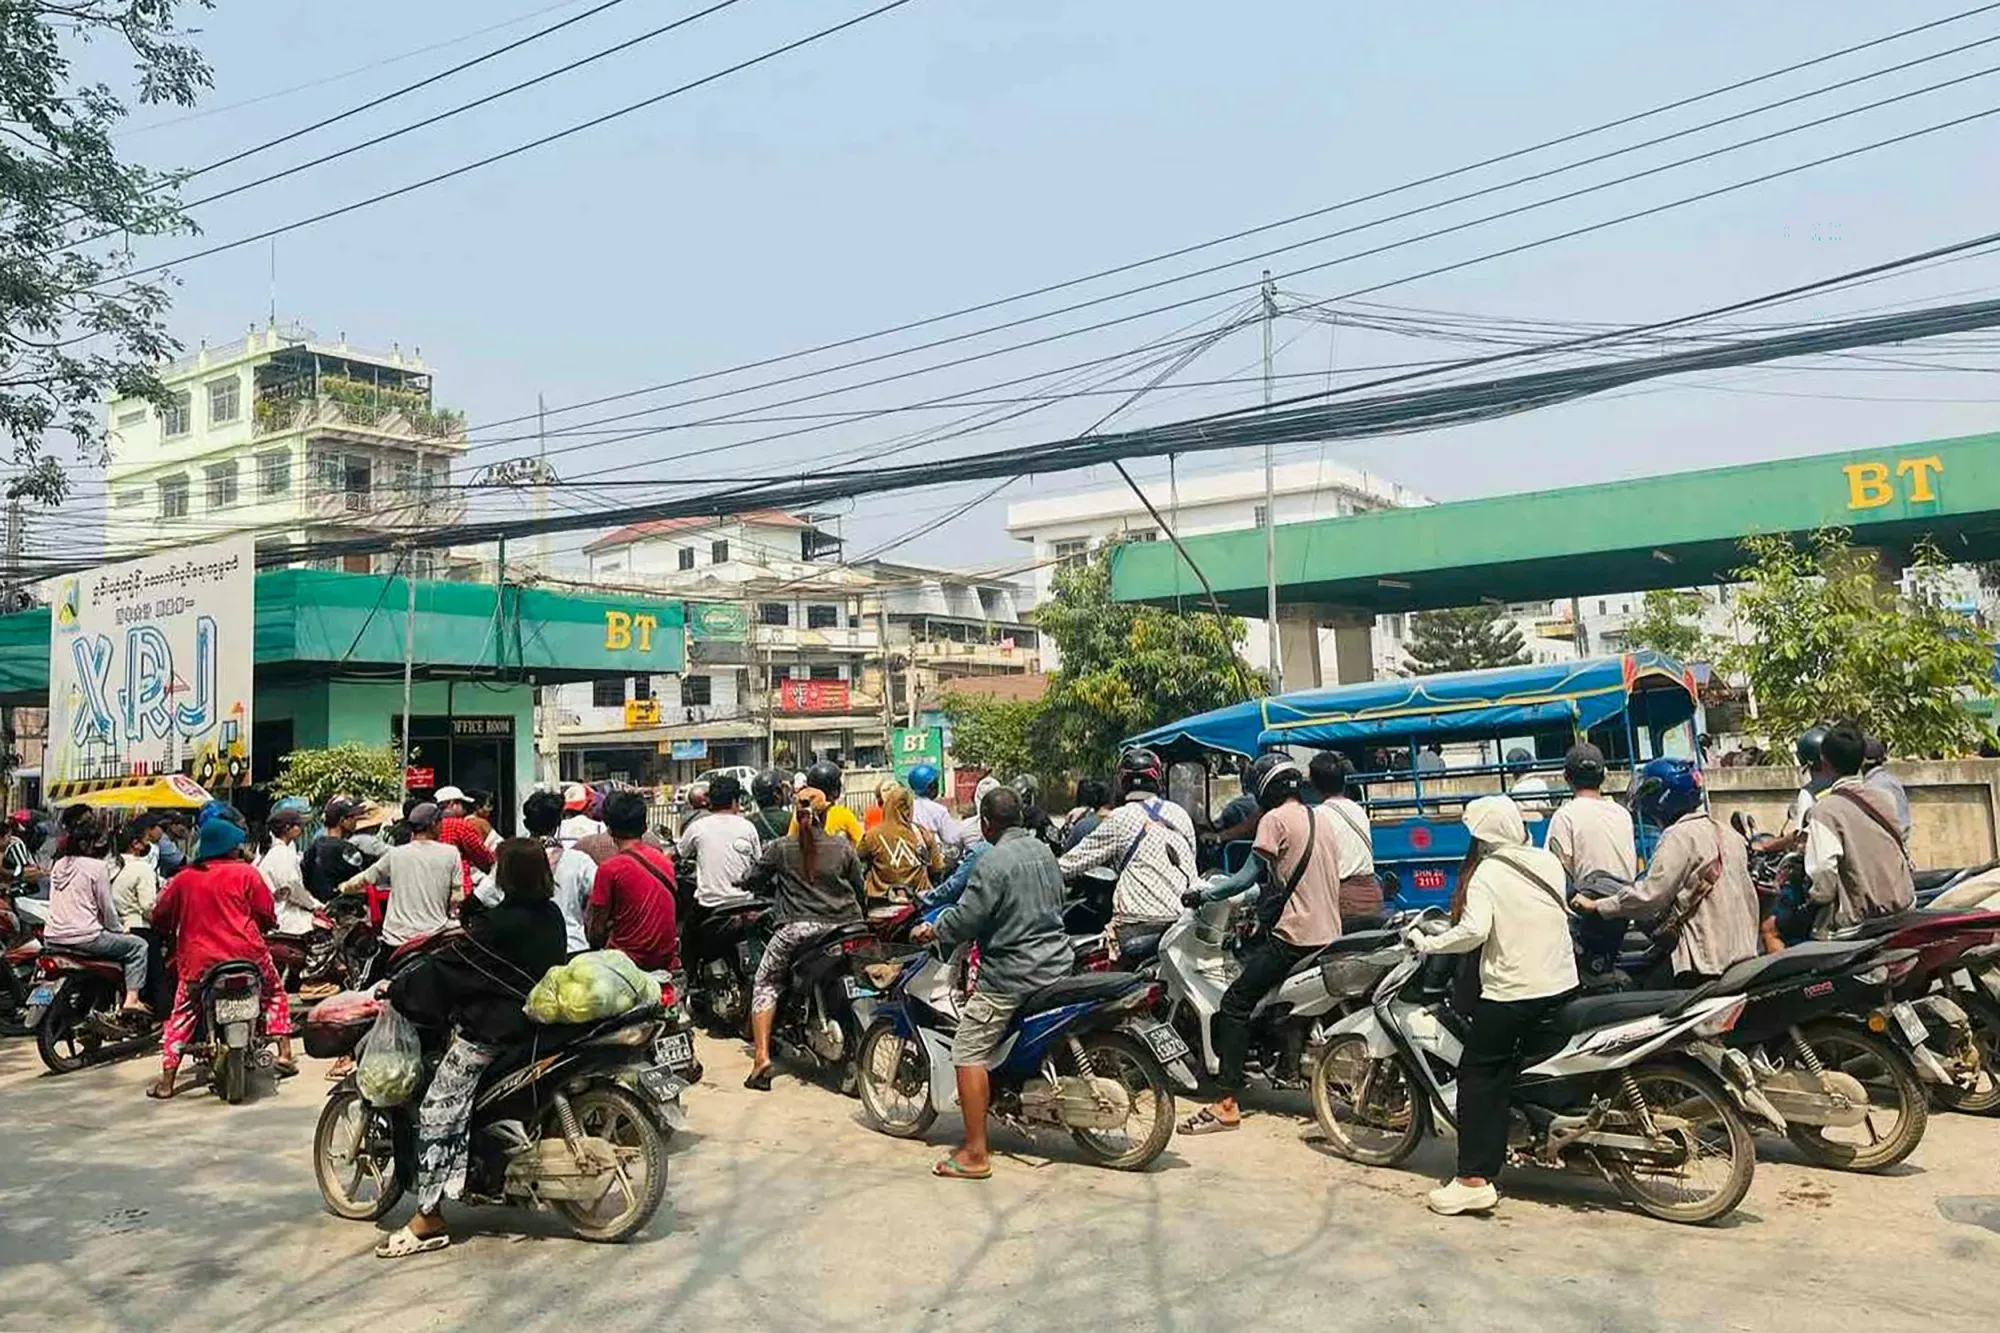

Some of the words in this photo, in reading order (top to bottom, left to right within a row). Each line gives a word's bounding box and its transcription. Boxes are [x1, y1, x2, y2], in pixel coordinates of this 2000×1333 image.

[1842, 455, 1944, 511] BT
[604, 610, 657, 652] BT
[903, 732, 928, 752] BT
